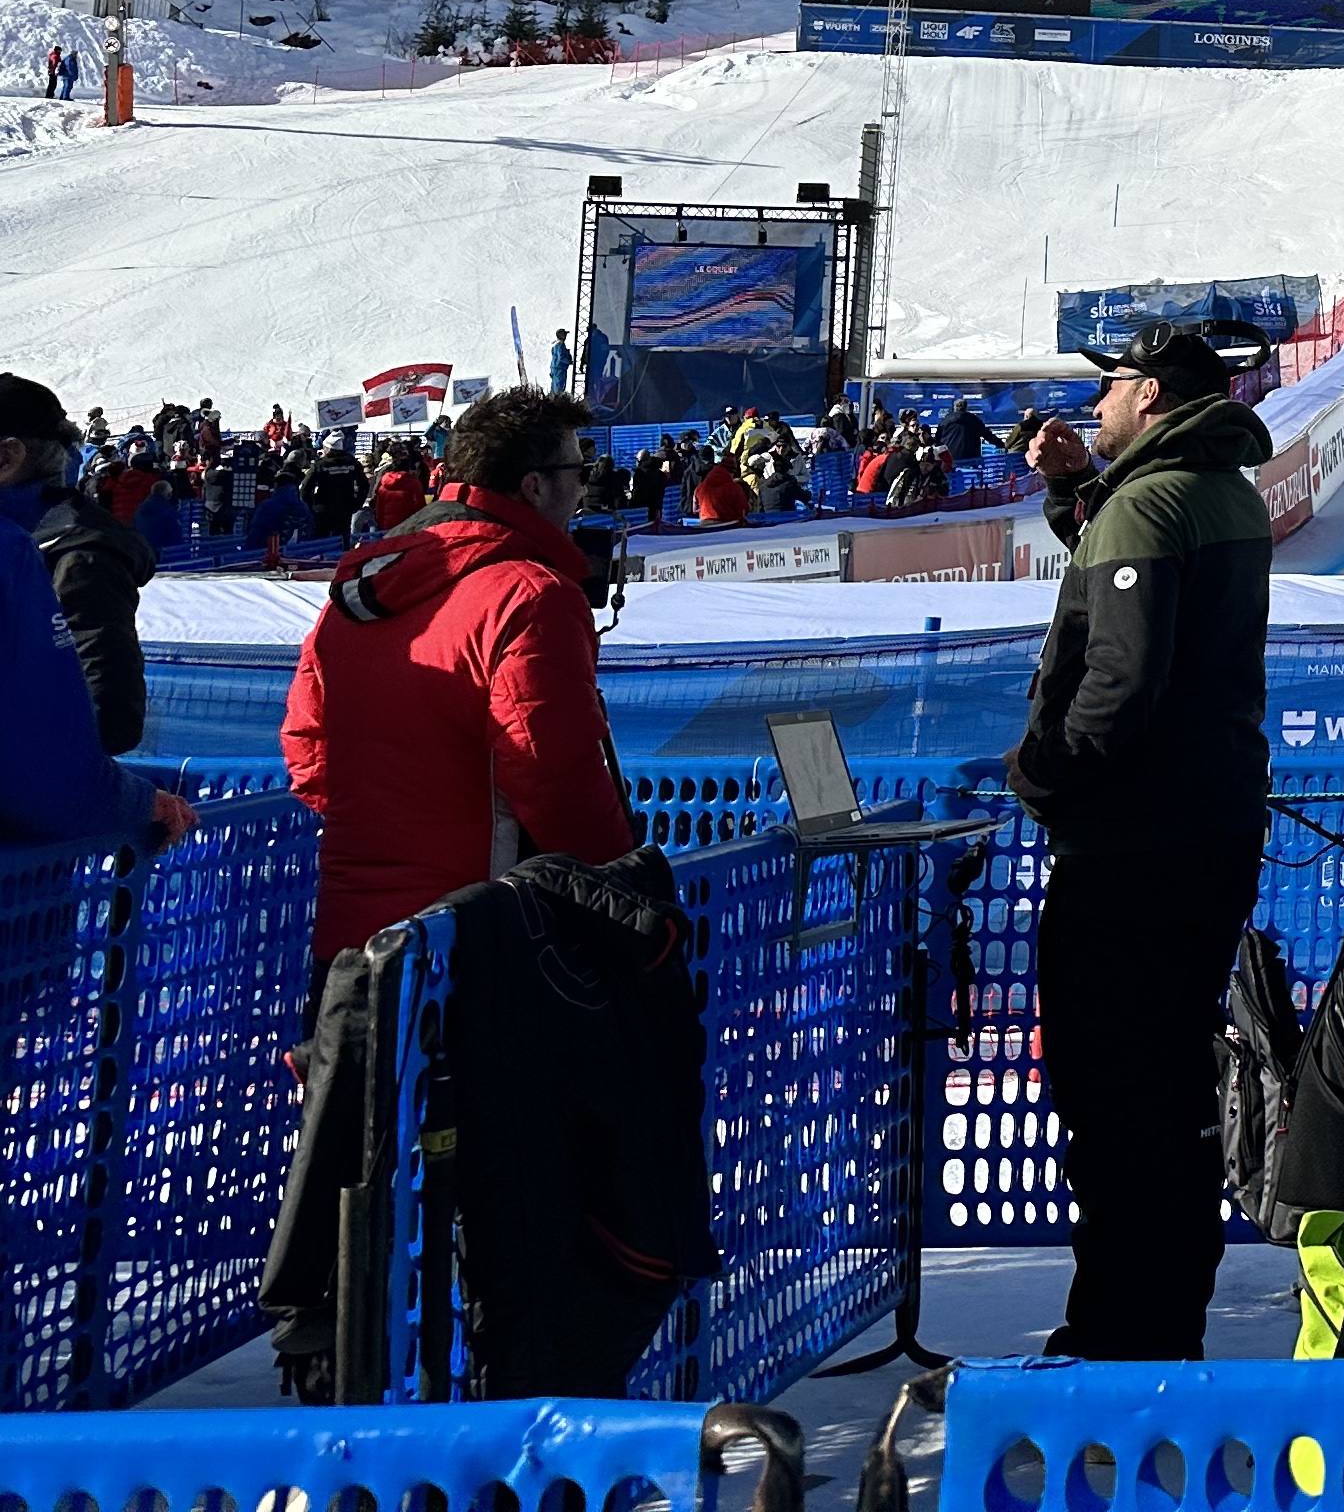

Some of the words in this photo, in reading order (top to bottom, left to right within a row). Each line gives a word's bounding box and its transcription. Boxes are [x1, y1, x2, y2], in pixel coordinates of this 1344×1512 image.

[1194, 33, 1270, 46] LONGINES
[1269, 463, 1310, 522] GENERALI
[706, 557, 738, 576] WÜRTH
[756, 552, 786, 569] WÜRTH
[803, 548, 831, 565] WÜRTH
[1307, 664, 1344, 676] MAIN
